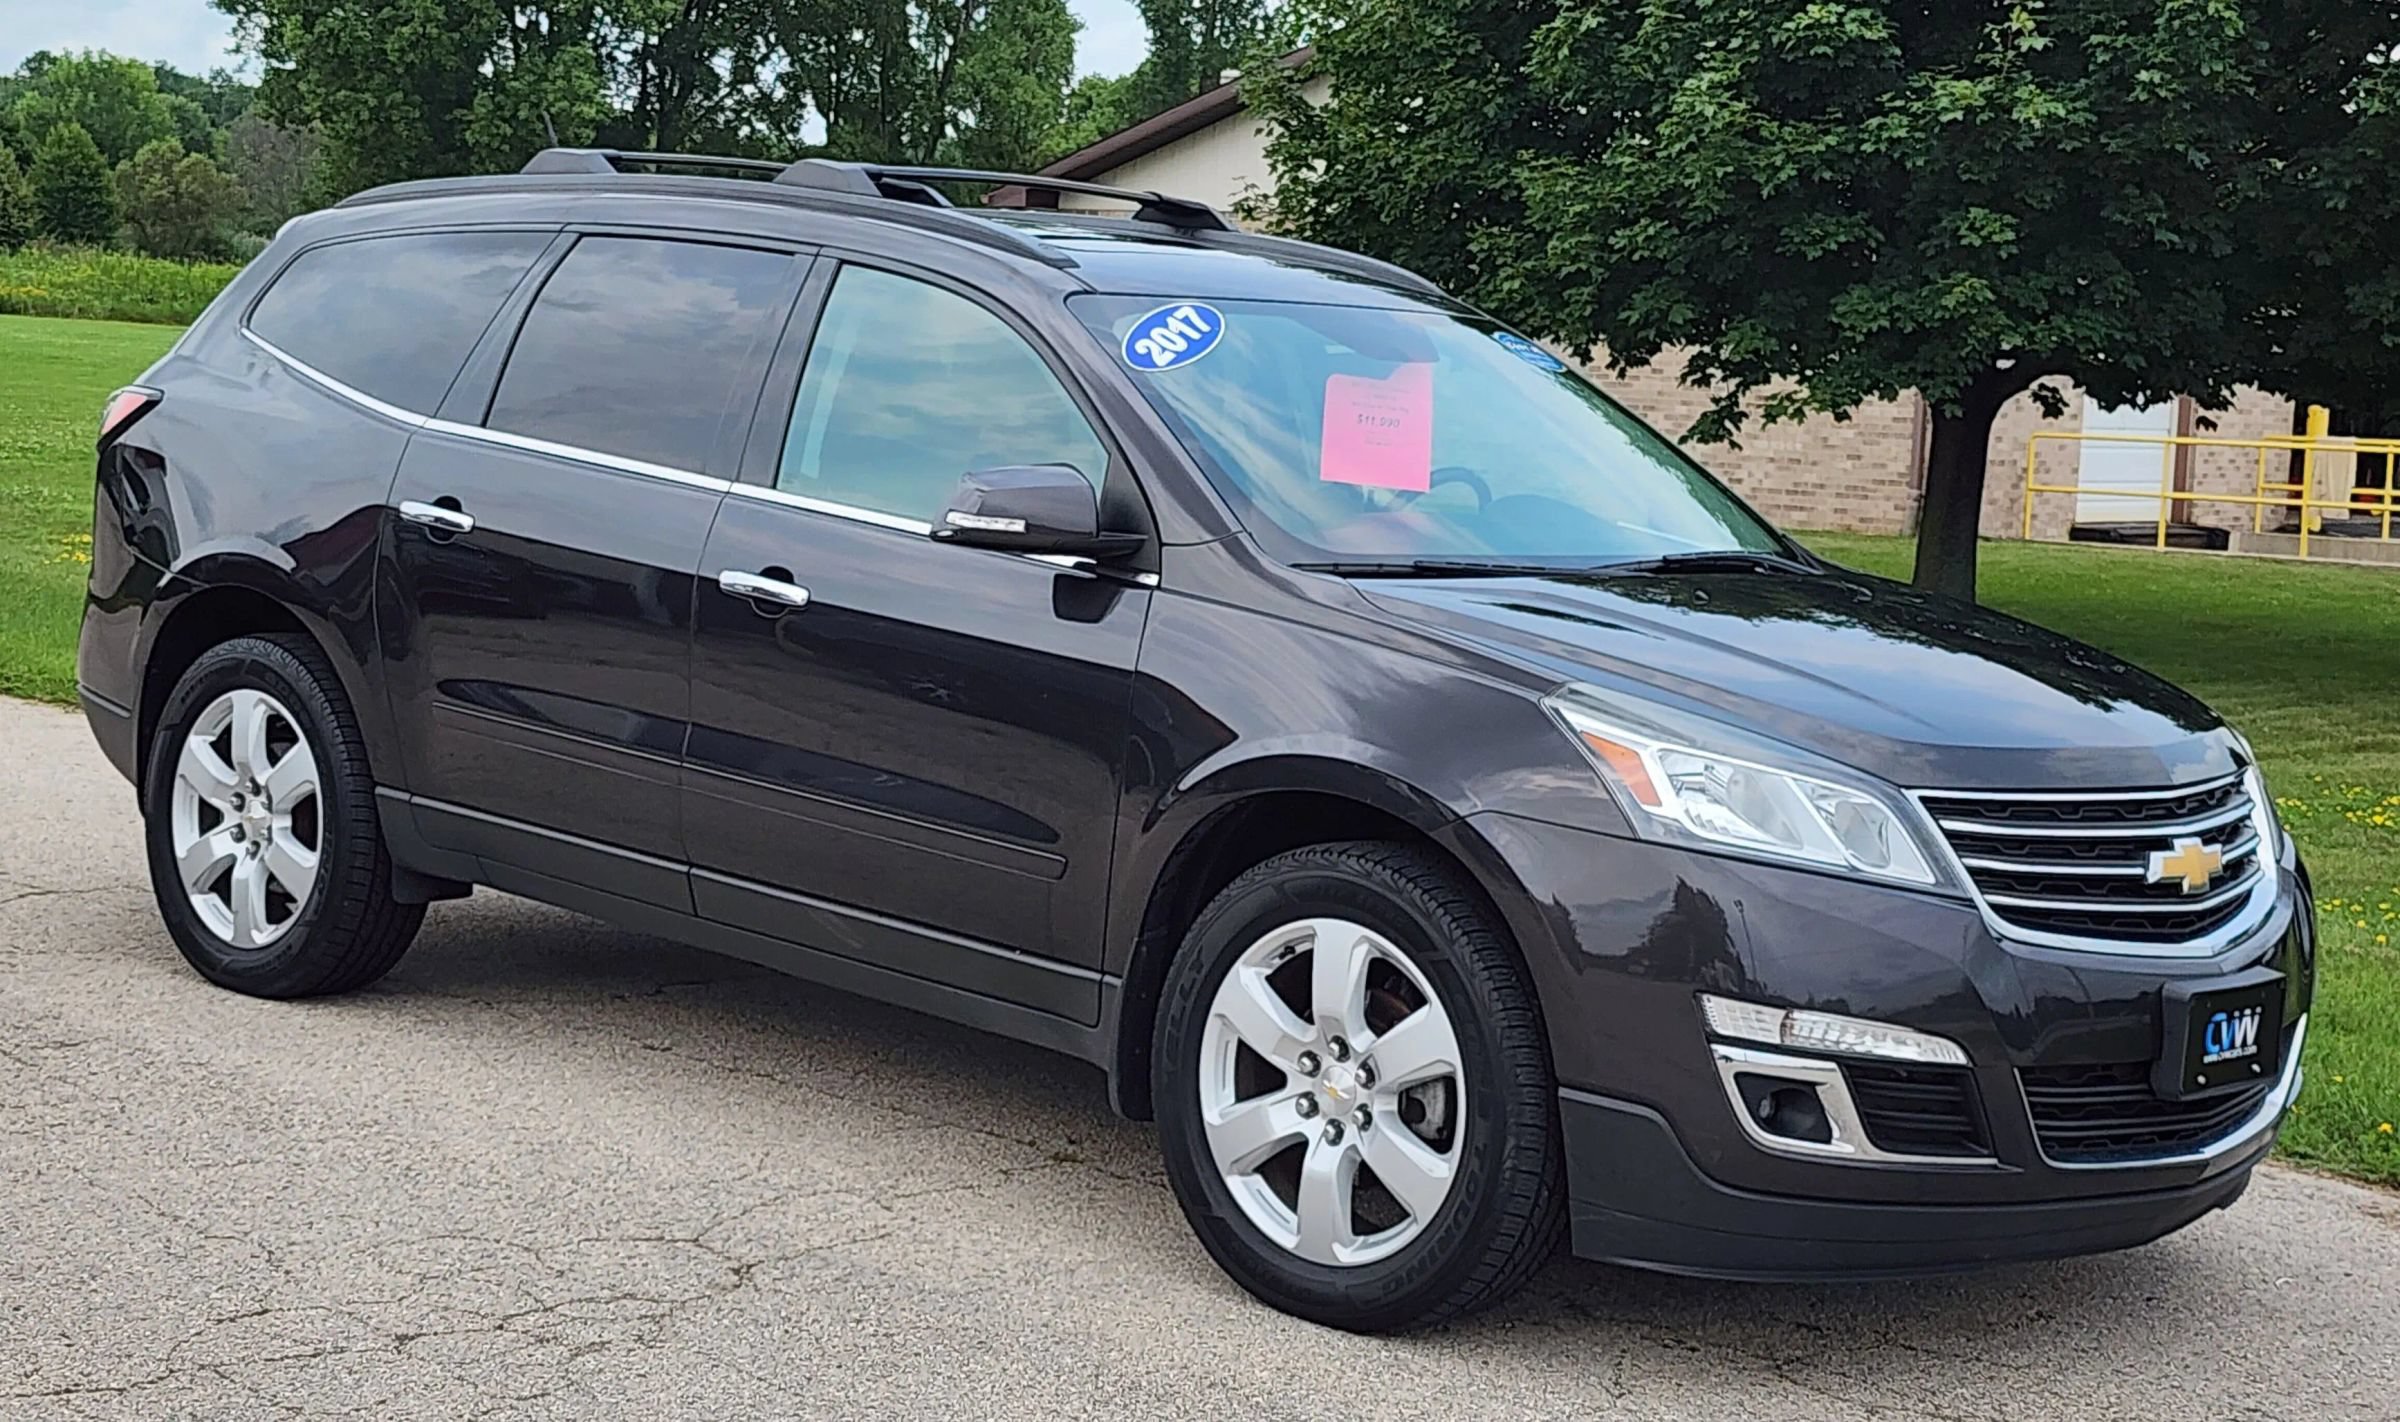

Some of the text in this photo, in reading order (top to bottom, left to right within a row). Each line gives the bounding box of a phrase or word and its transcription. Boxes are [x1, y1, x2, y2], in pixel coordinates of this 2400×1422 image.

[1134, 305, 1212, 367] 2017
[2205, 1006, 2262, 1054] CVW
[1379, 1132, 1489, 1292] TOURING
